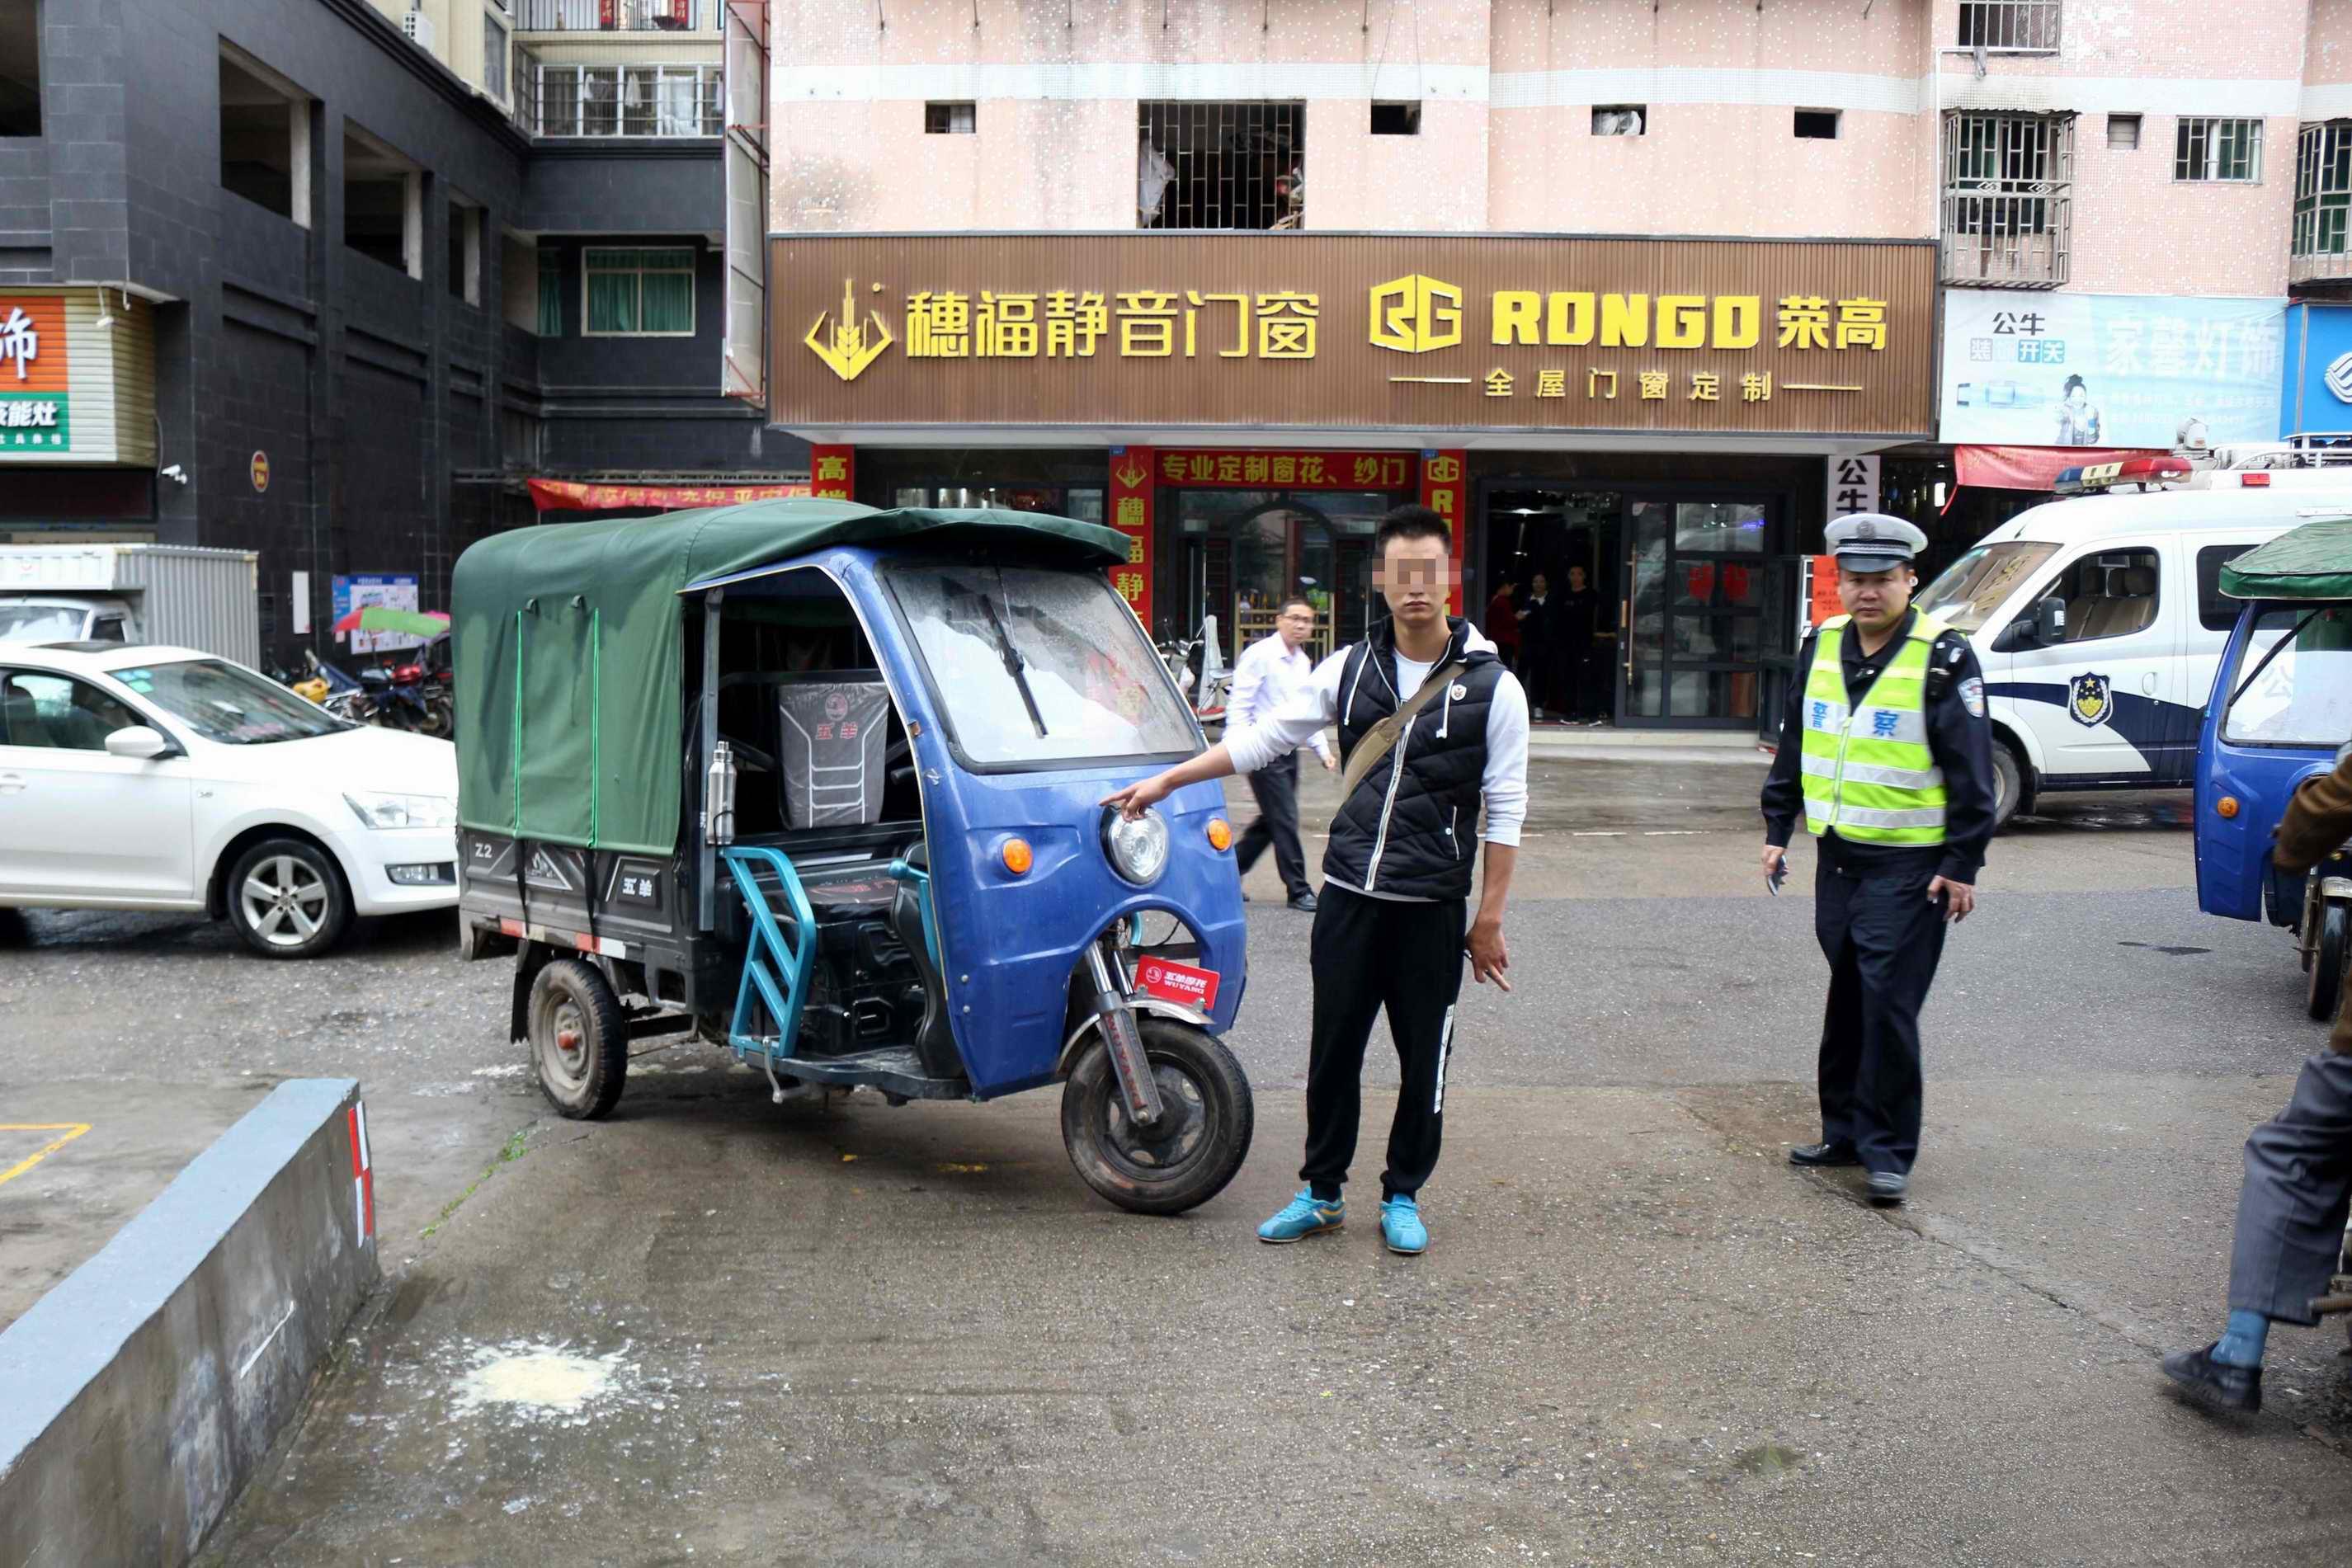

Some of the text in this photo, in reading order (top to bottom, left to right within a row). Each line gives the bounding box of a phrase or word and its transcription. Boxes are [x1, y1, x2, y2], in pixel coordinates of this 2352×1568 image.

[907, 290, 1320, 359] 穗福静音门窗
[1492, 290, 1760, 349] RONGO
[1778, 294, 1888, 351] 荣高
[1992, 312, 2045, 336] 公牛
[1484, 367, 1773, 403] 全屋门窗定制
[1836, 459, 1868, 514] 公牛
[475, 843, 493, 859] Z2
[622, 878, 652, 897] 五羊
[1164, 980, 1204, 994] WUYANG
